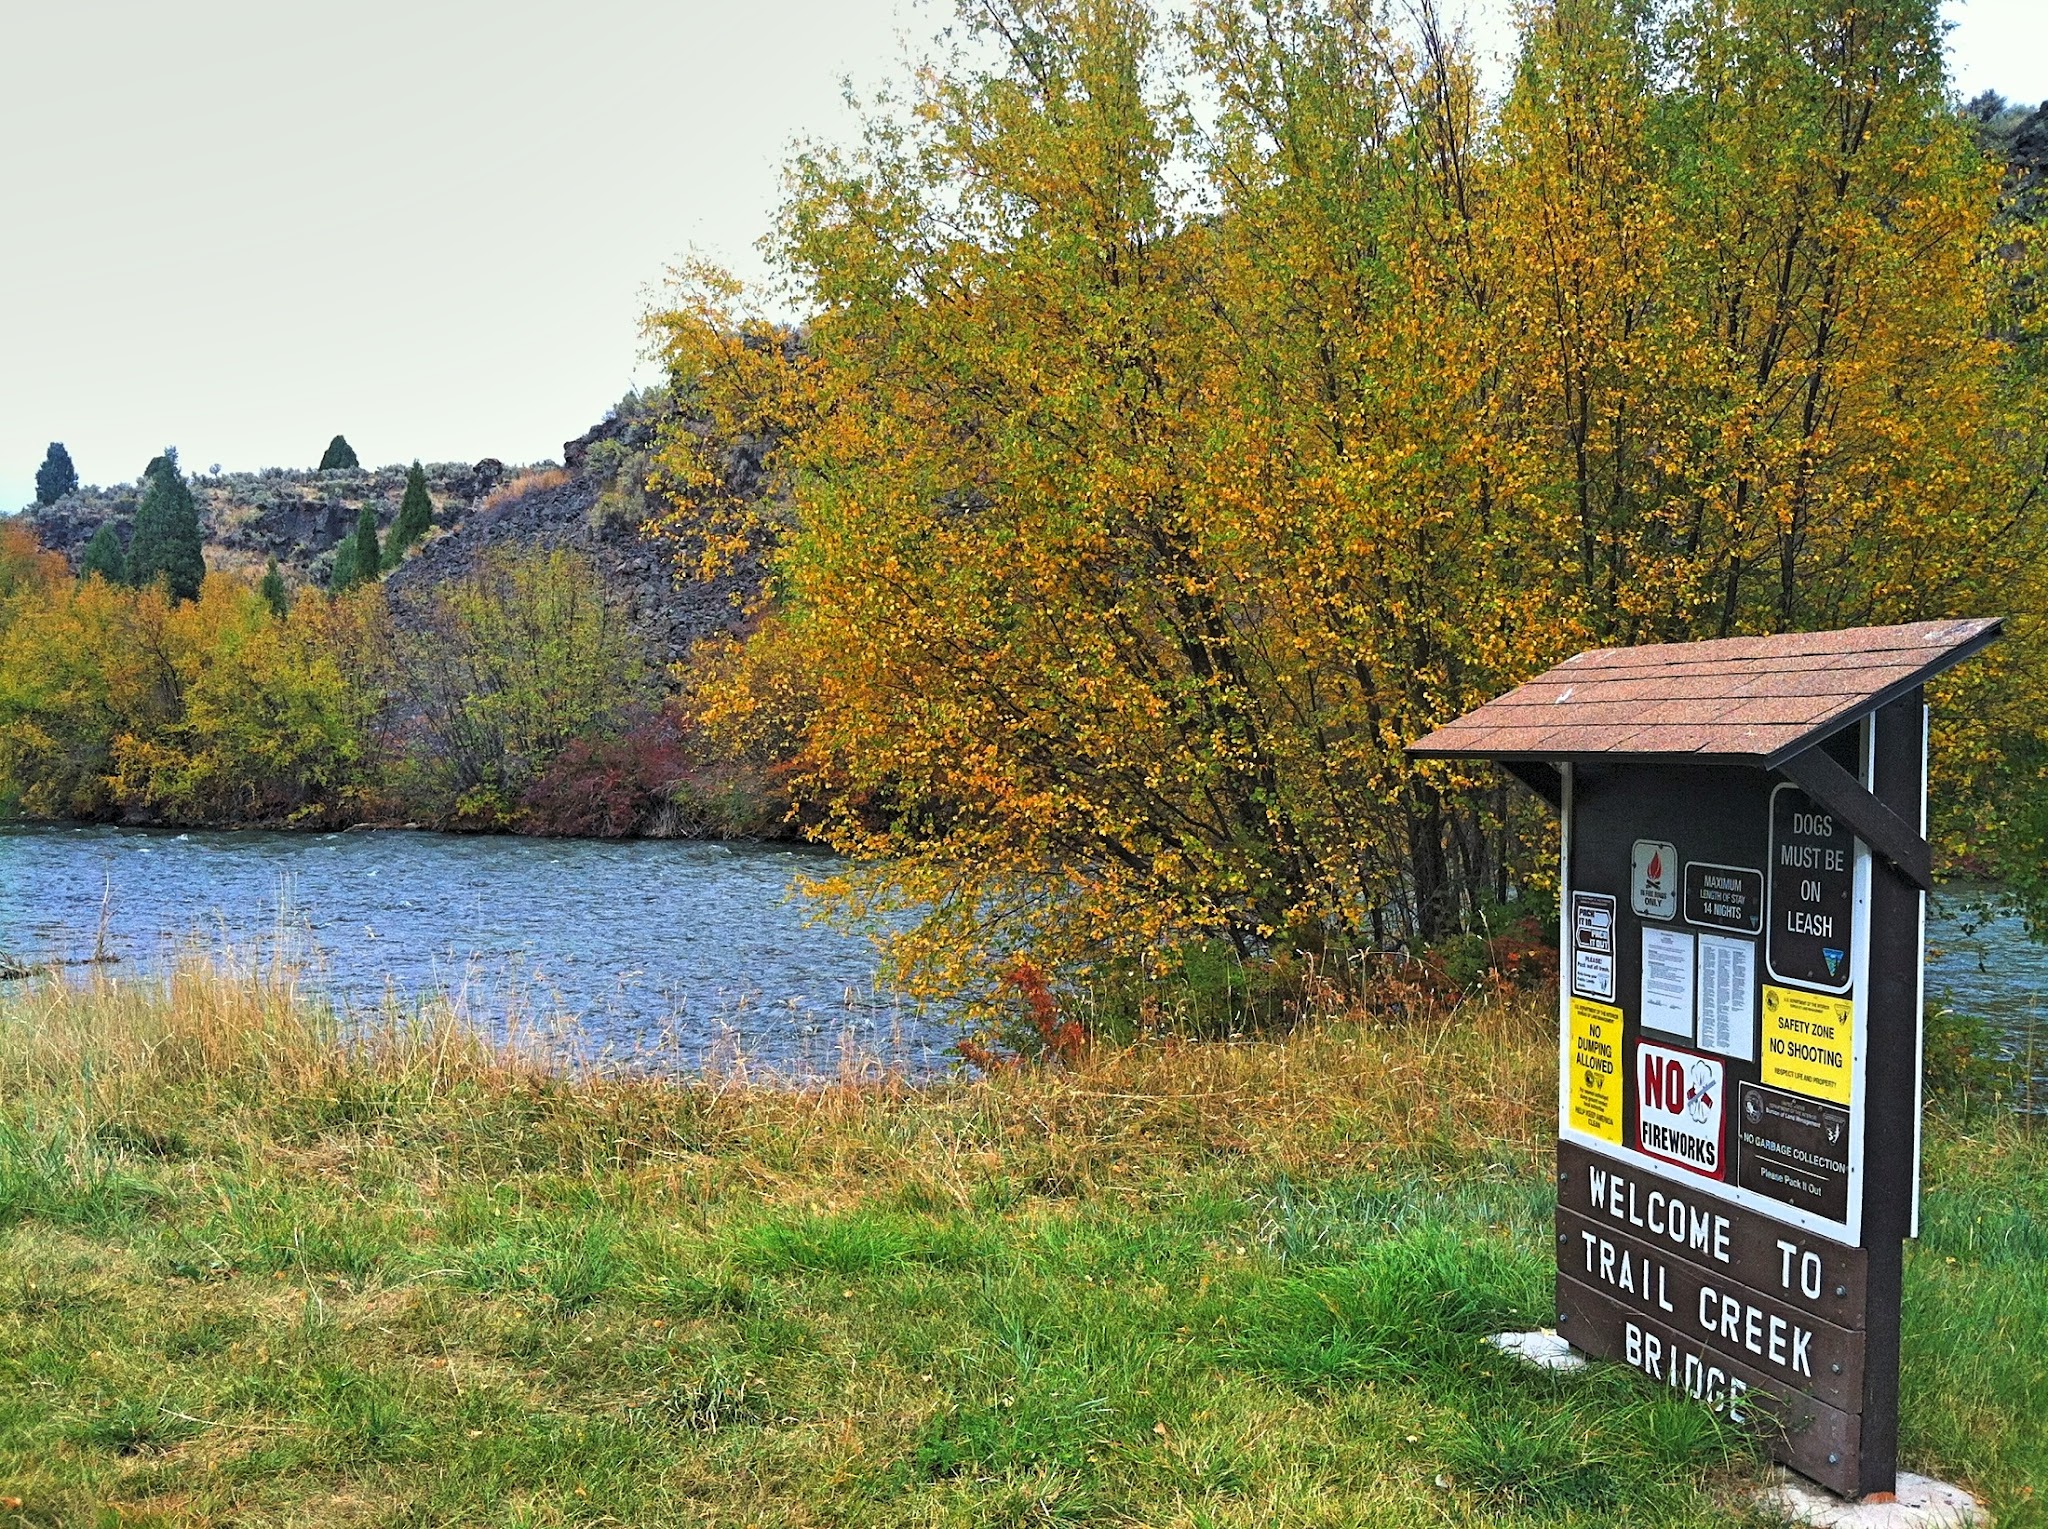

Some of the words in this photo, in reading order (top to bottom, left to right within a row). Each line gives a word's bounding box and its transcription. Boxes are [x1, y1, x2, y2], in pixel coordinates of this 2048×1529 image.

[1793, 813, 1833, 837] DOGS
[1781, 845, 1821, 869] MUST
[1825, 849, 1844, 872] BE
[1703, 875, 1742, 892] MAXIMUM
[1801, 880, 1821, 903] ON
[1645, 897, 1662, 907] ONLY
[1700, 889, 1722, 901] LENGTH
[1723, 892, 1731, 902] OF
[1731, 894, 1746, 905] STAY
[1703, 902, 1713, 914] 14
[1713, 903, 1742, 920] NIGHTS
[1787, 910, 1833, 938] LEASH
[1590, 1024, 1601, 1038] NO
[1778, 1016, 1810, 1034] SAFETY
[1812, 1023, 1835, 1040] ZONE
[1578, 1036, 1612, 1058] DUMPING
[1769, 1037, 1785, 1055] NO
[1787, 1041, 1842, 1068] SHOOTING
[1576, 1052, 1614, 1075] ALLOWED
[1644, 1053, 1685, 1116] NO
[1774, 1067, 1794, 1078] RESPECT
[1812, 1077, 1837, 1088] PROPERTY
[1642, 1120, 1716, 1167] FIREWORKS
[1743, 1132, 1754, 1144] NO
[1755, 1136, 1792, 1157] GARBAGE
[1793, 1148, 1846, 1174] COLLECTION
[1760, 1167, 1784, 1183] Please
[1784, 1174, 1801, 1190] Pack
[1808, 1184, 1822, 1197] Out
[1589, 1166, 1730, 1264] WELCOME
[1777, 1239, 1822, 1300] TO
[1581, 1230, 1674, 1313] TRAIL
[1699, 1286, 1812, 1378] CREEK
[1625, 1321, 1747, 1424] BRIDGE
